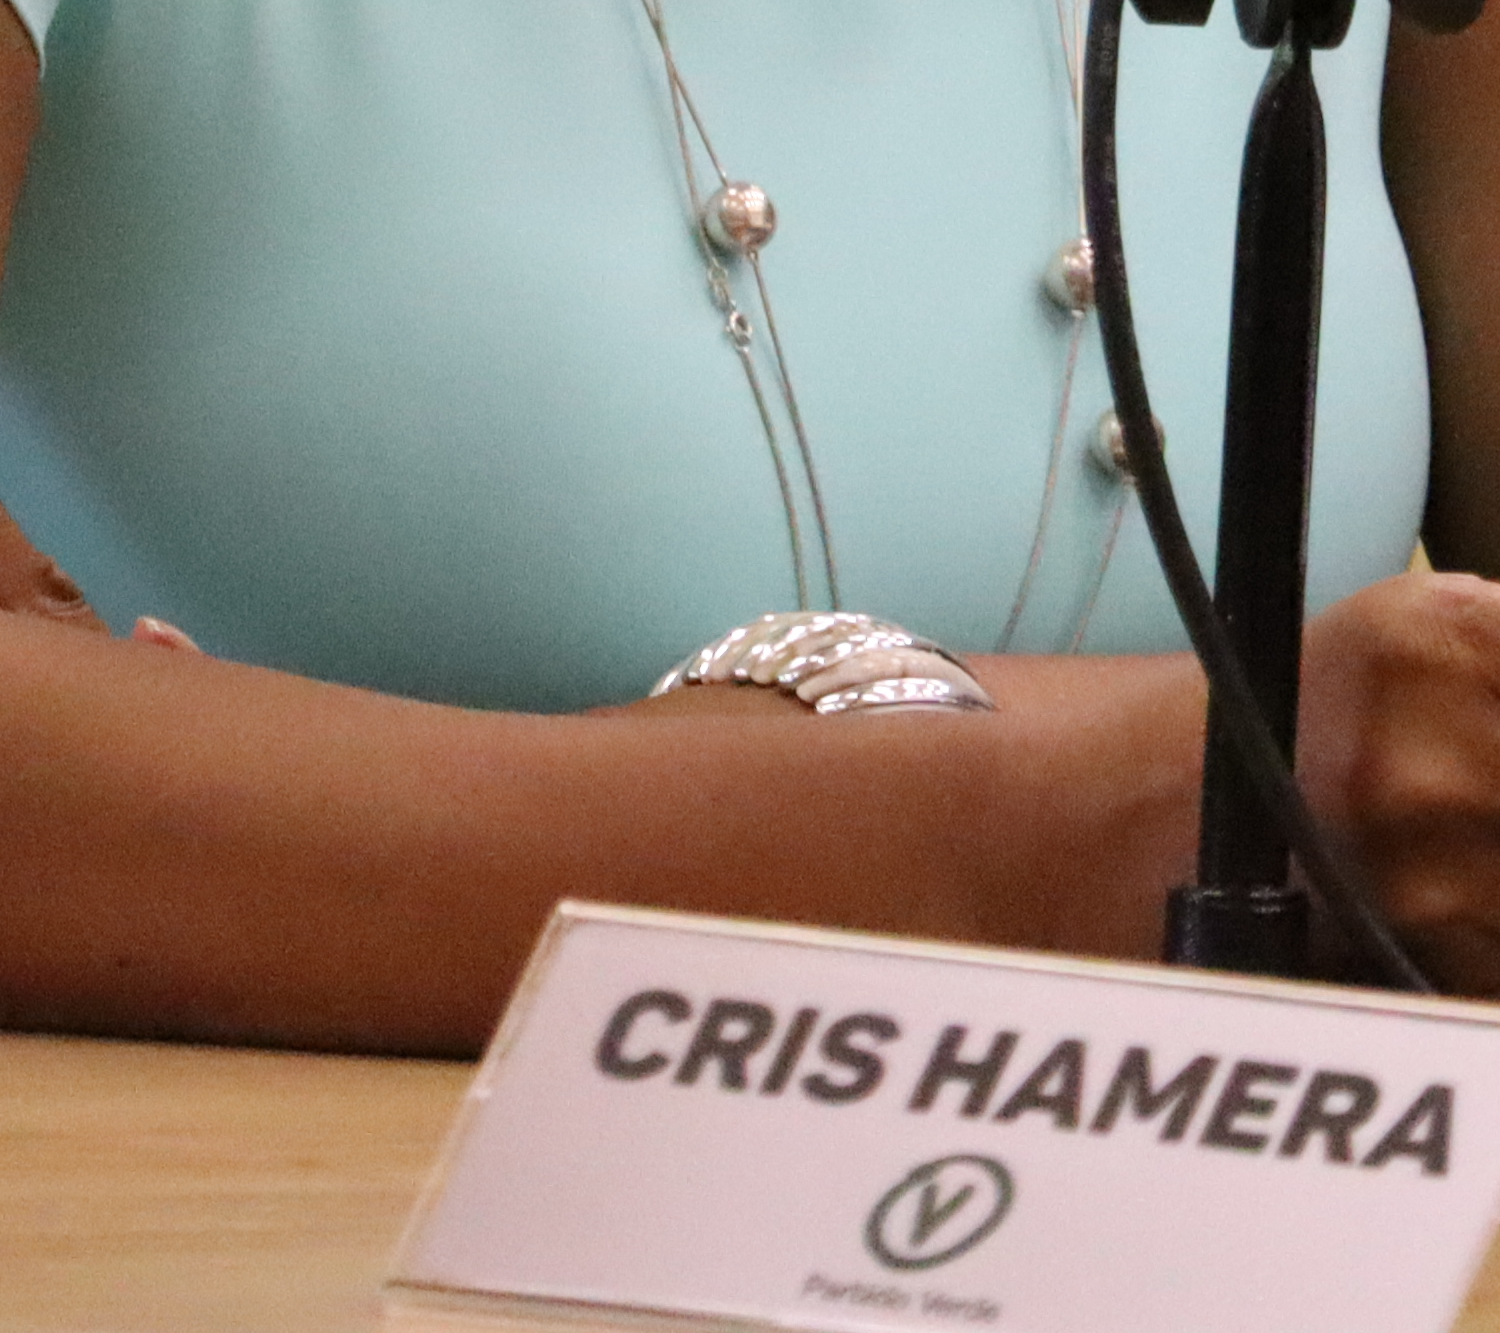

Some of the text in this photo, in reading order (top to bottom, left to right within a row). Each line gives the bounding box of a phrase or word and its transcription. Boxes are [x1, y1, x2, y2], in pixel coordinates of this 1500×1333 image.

[596, 990, 1455, 1177] CRIS HAMERA
[921, 1290, 1000, 1324] Verde
